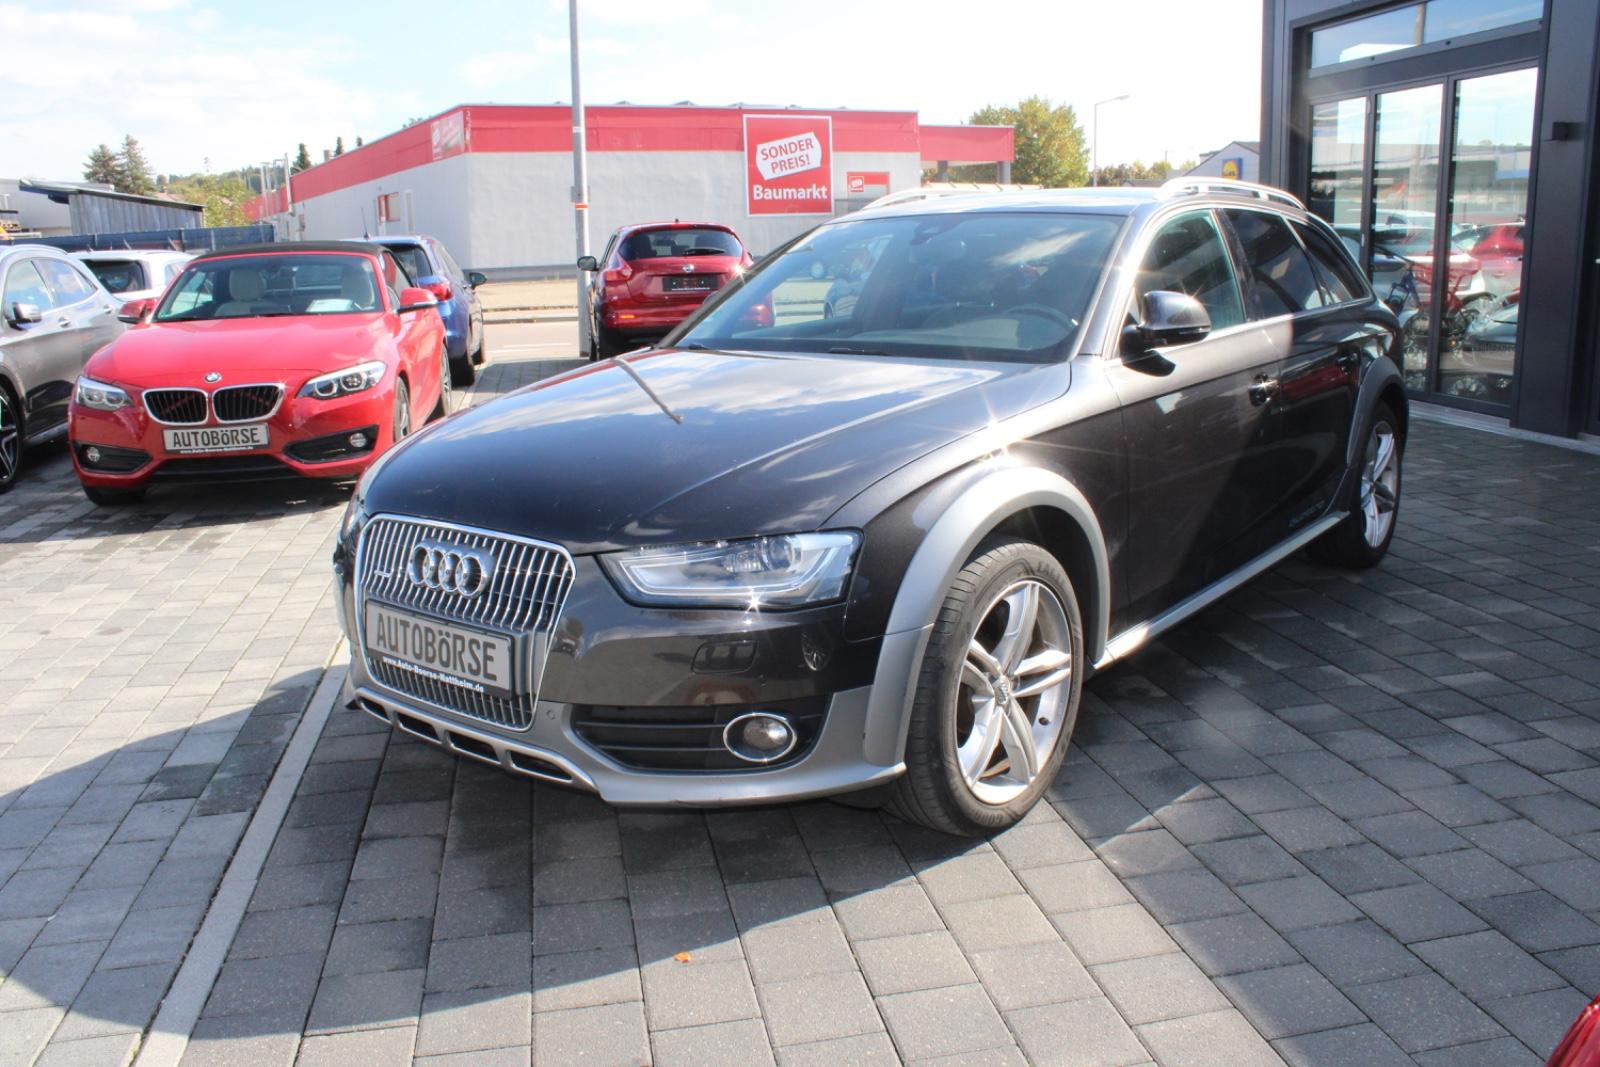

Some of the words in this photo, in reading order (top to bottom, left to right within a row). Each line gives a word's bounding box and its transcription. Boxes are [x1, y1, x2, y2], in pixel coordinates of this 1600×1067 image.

[760, 137, 814, 161] SONDER
[770, 154, 811, 174] PREIS!
[752, 184, 828, 200] Baumarkt
